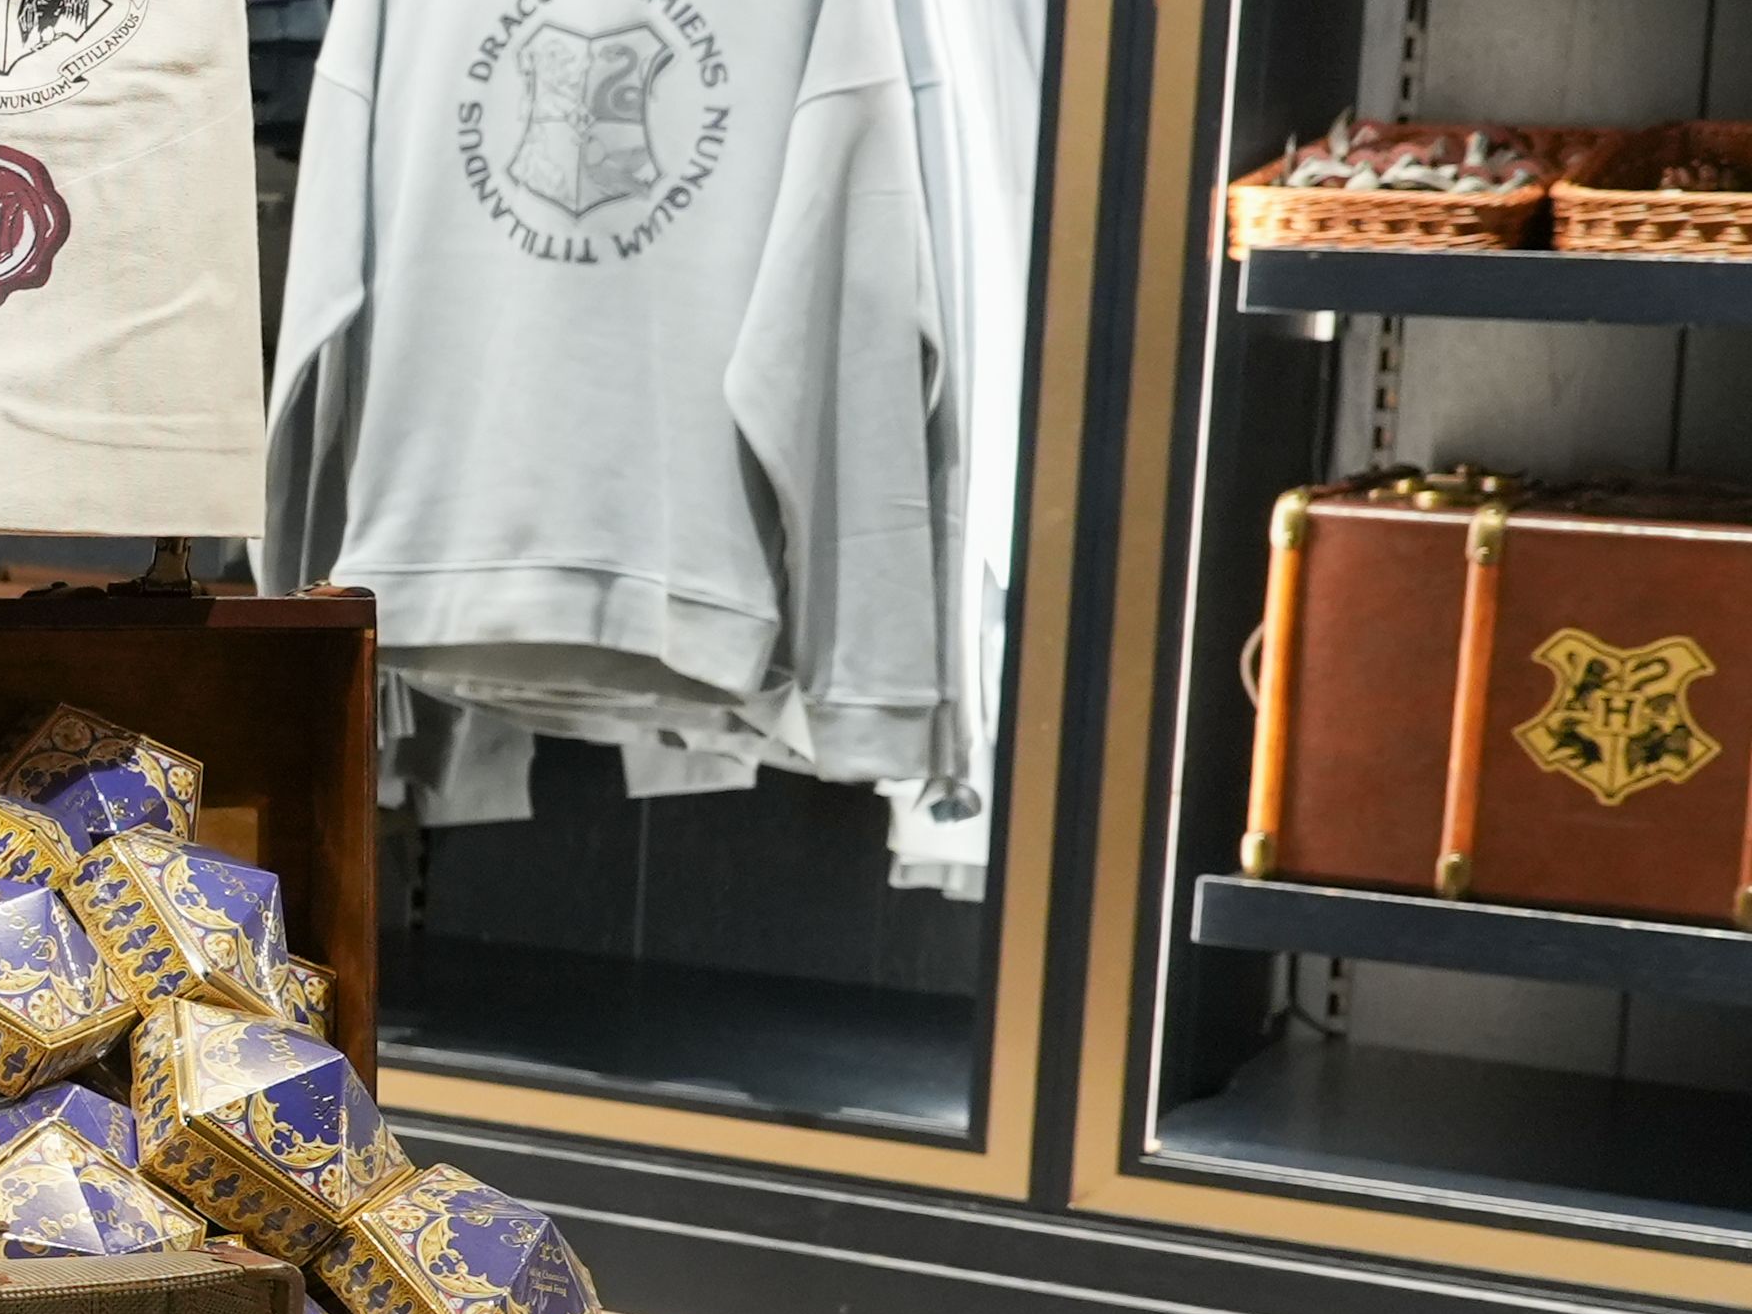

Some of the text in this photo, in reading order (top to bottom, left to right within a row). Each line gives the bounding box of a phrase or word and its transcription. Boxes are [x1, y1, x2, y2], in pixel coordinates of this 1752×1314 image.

[0, 80, 73, 110] NUNQUAM
[63, 13, 141, 78] TITILLANDUS
[457, 100, 599, 264] TITILLANDUS
[610, 105, 730, 260] NUNQUAM
[1598, 696, 1633, 728] H
